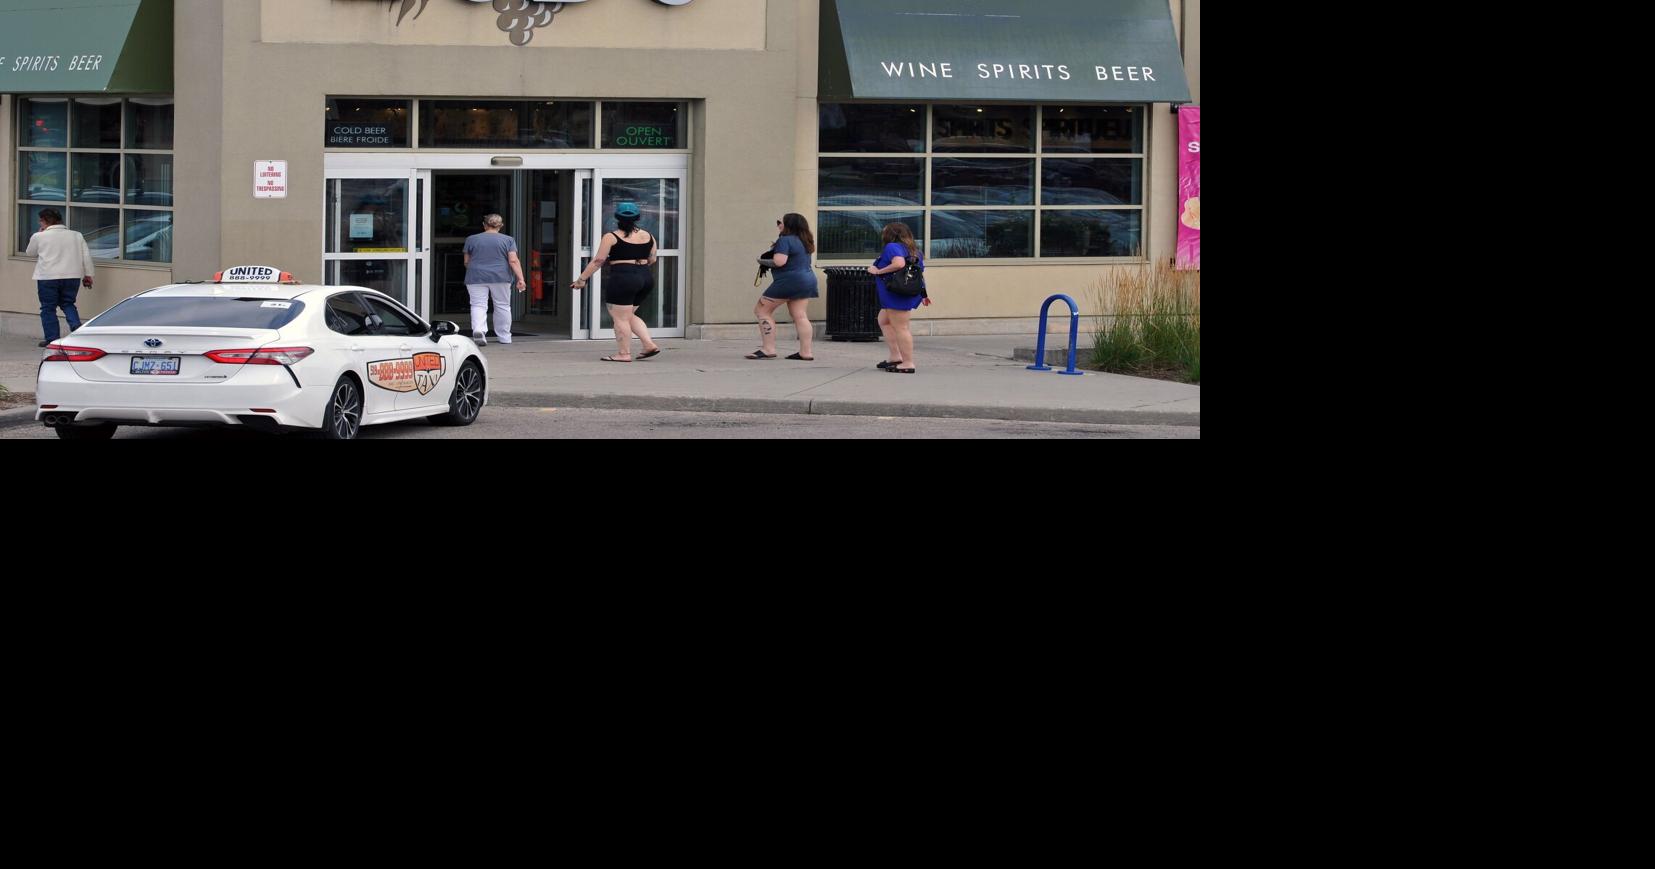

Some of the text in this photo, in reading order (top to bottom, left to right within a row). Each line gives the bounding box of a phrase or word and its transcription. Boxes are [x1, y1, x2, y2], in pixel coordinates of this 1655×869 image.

[12, 56, 60, 72] SPIRITS
[68, 55, 102, 71] BEER
[881, 62, 1156, 82] WINE SPIRITS BEER
[333, 126, 386, 135] COLD BEER
[626, 126, 662, 136] OPEN
[356, 136, 389, 144] FROIDE
[616, 136, 669, 146] OUVERT
[229, 267, 273, 276] UNITED
[417, 373, 438, 392] TAXI
